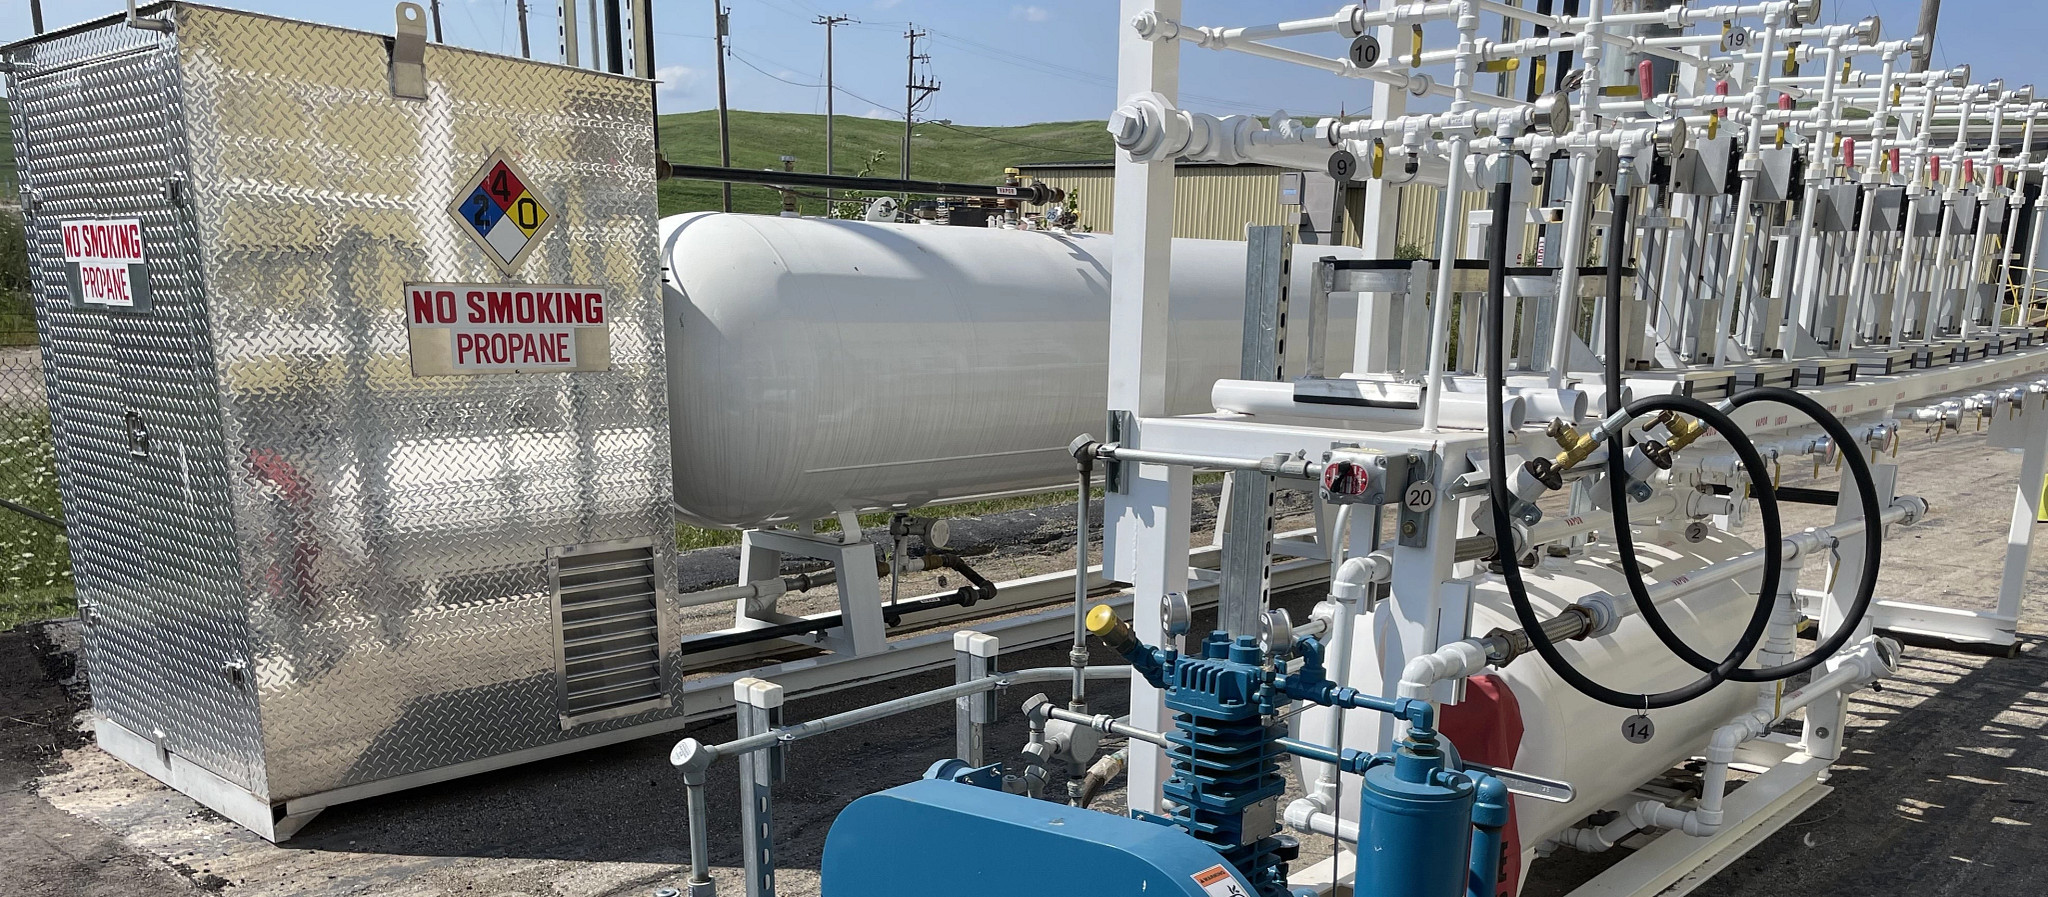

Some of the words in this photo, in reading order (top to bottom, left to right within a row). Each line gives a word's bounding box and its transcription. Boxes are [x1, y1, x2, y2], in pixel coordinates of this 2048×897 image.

[1728, 33, 1745, 46] 19
[1355, 44, 1376, 63] 10
[1337, 159, 1347, 176] 9
[491, 170, 511, 202] 4
[473, 194, 491, 227] 2
[518, 198, 539, 229] 0
[1047, 211, 1056, 220] 25
[63, 225, 81, 258] NO
[82, 224, 141, 259] SMOKING
[412, 291, 457, 324] NO
[466, 291, 604, 324] SMOKING
[457, 332, 571, 364] PROPANE
[1755, 416, 1768, 427] VAPOR
[1409, 489, 1432, 506] 20
[1564, 516, 1583, 527] VAPOR
[1692, 528, 1701, 539] 2
[1671, 575, 1689, 586] VAPOR
[1628, 723, 1650, 739] 14
[1204, 871, 1225, 881] WARNING
